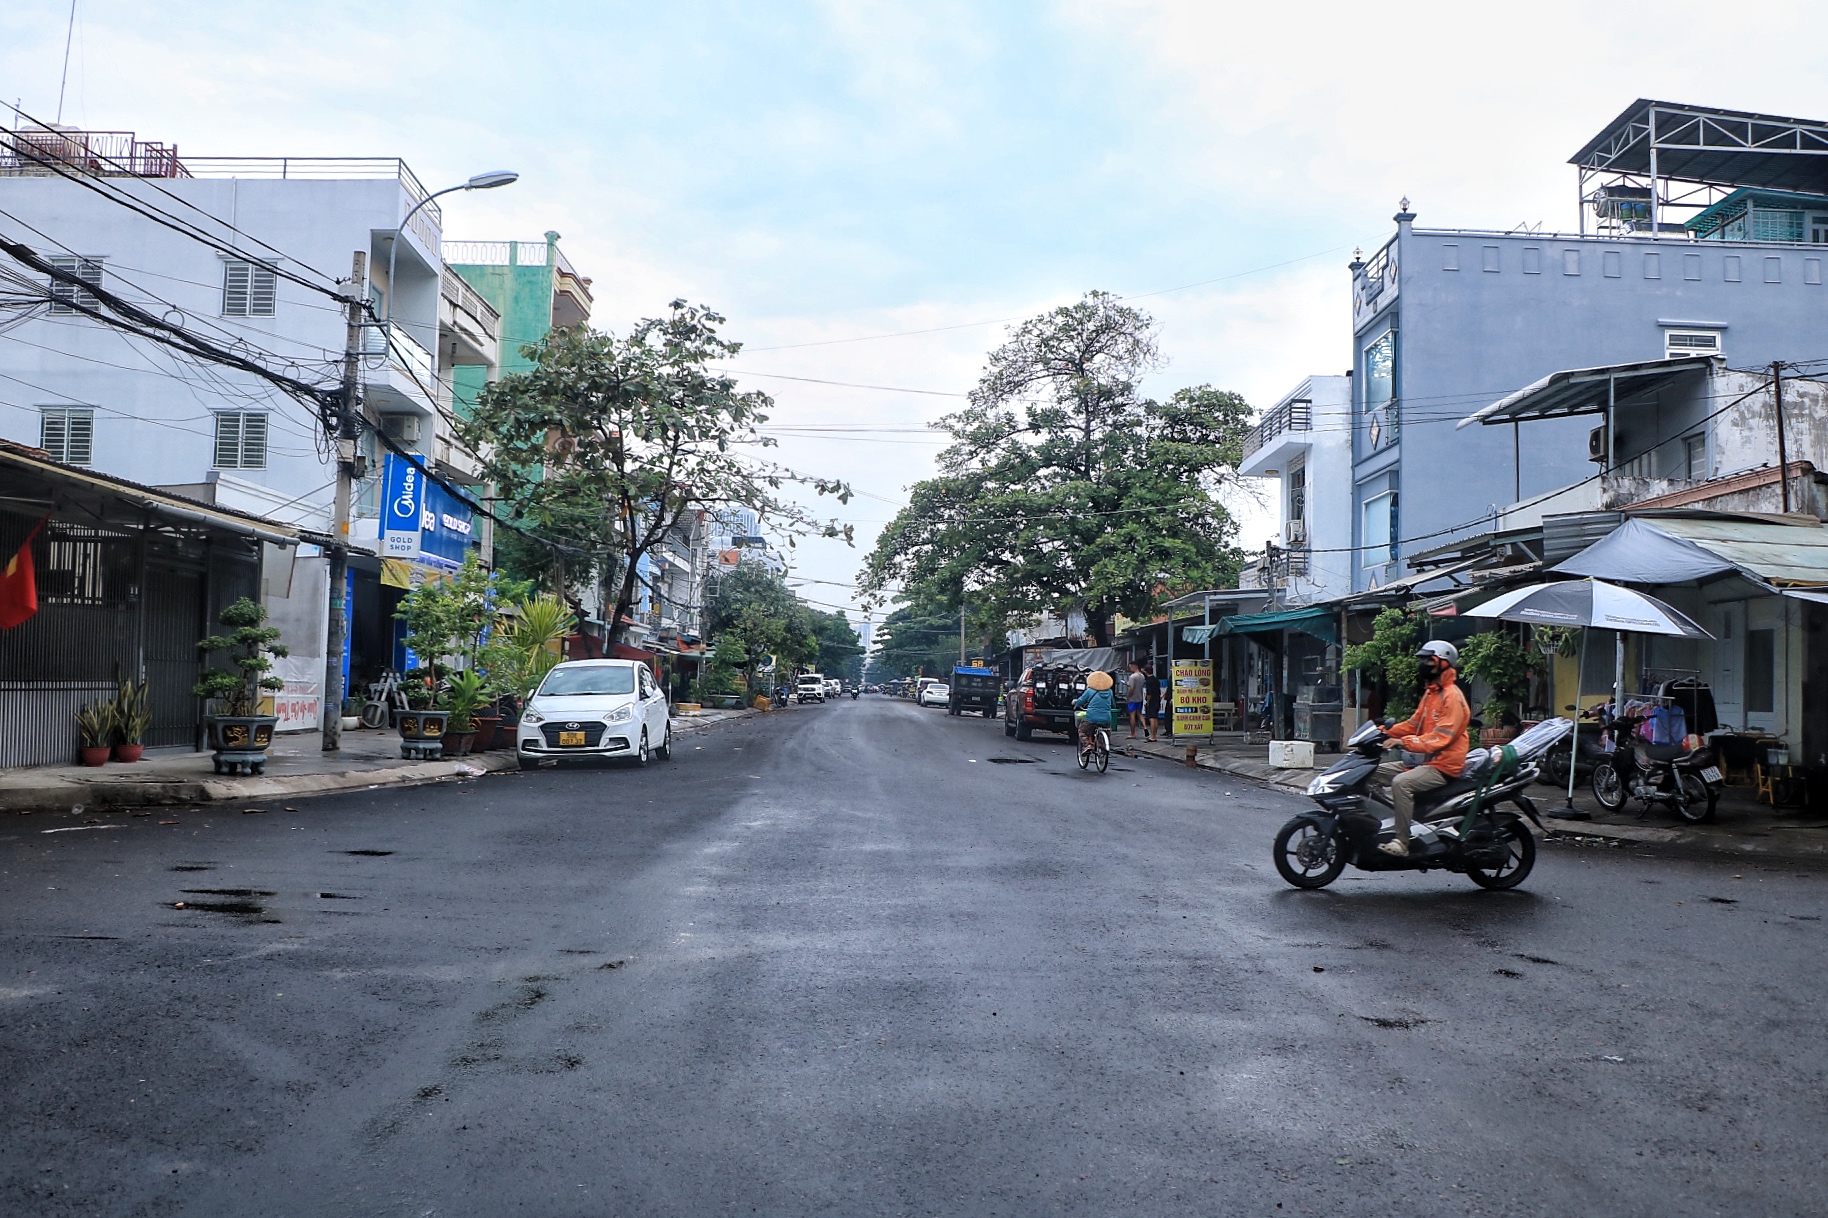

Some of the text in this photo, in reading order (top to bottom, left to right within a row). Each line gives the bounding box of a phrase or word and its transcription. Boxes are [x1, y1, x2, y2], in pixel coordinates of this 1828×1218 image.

[393, 467, 416, 518] Midea
[390, 536, 413, 544] GOLD
[1192, 696, 1207, 704] KHO
